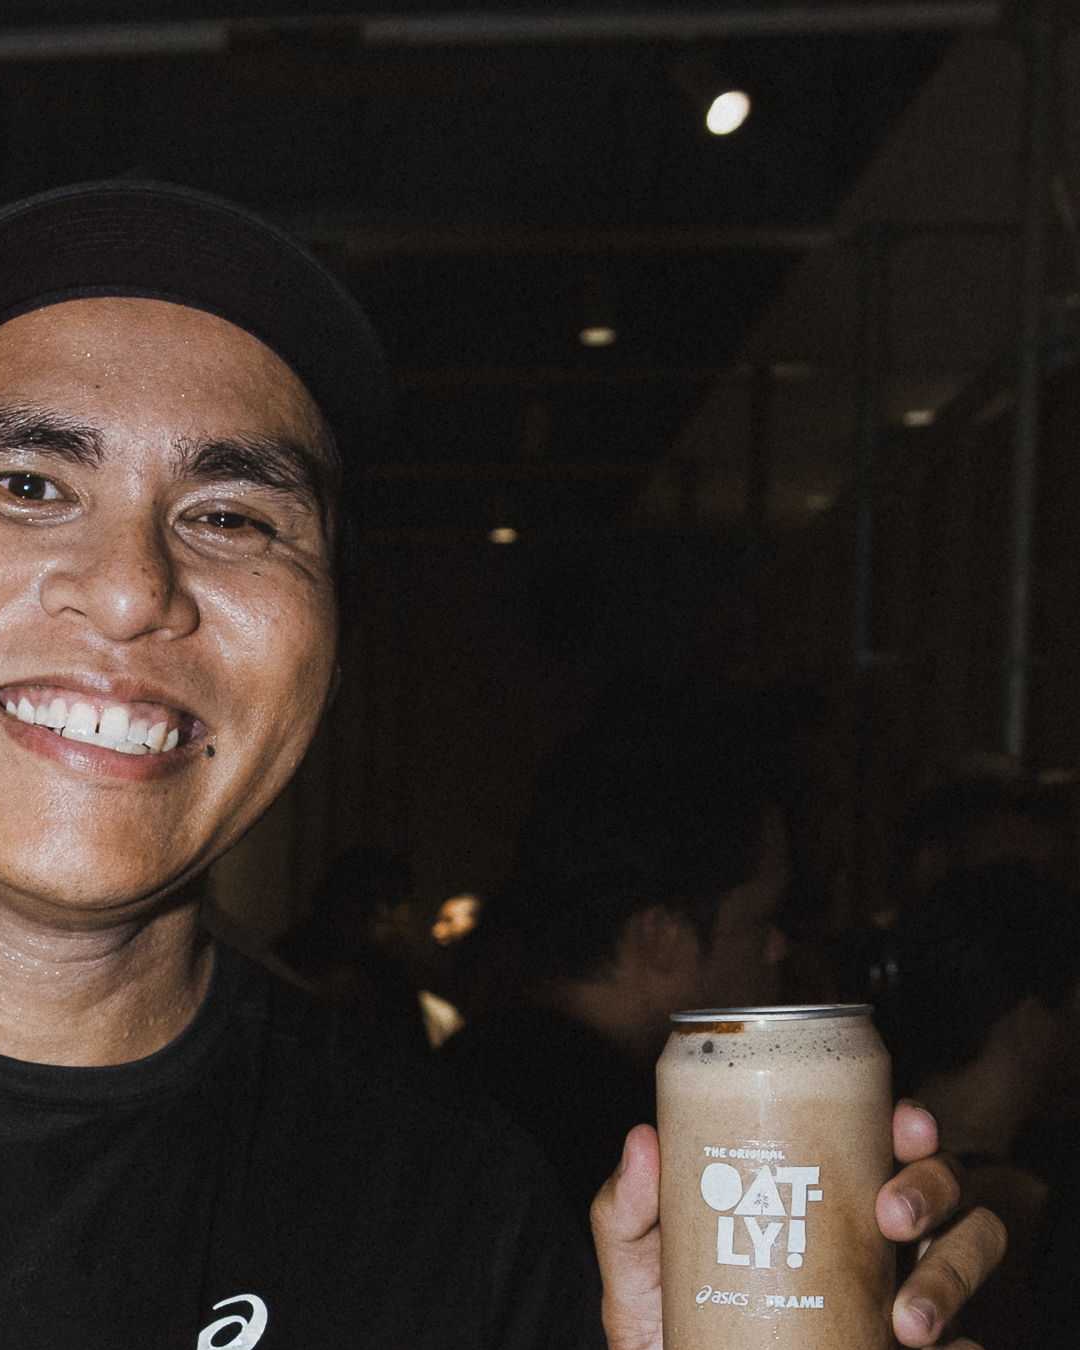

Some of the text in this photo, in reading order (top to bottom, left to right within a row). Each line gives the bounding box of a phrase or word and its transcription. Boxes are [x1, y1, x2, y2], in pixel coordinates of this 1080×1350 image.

[703, 1146, 786, 1161] THE ORIGINAL
[717, 1216, 806, 1269] LY!
[765, 1294, 824, 1309] FRAME
